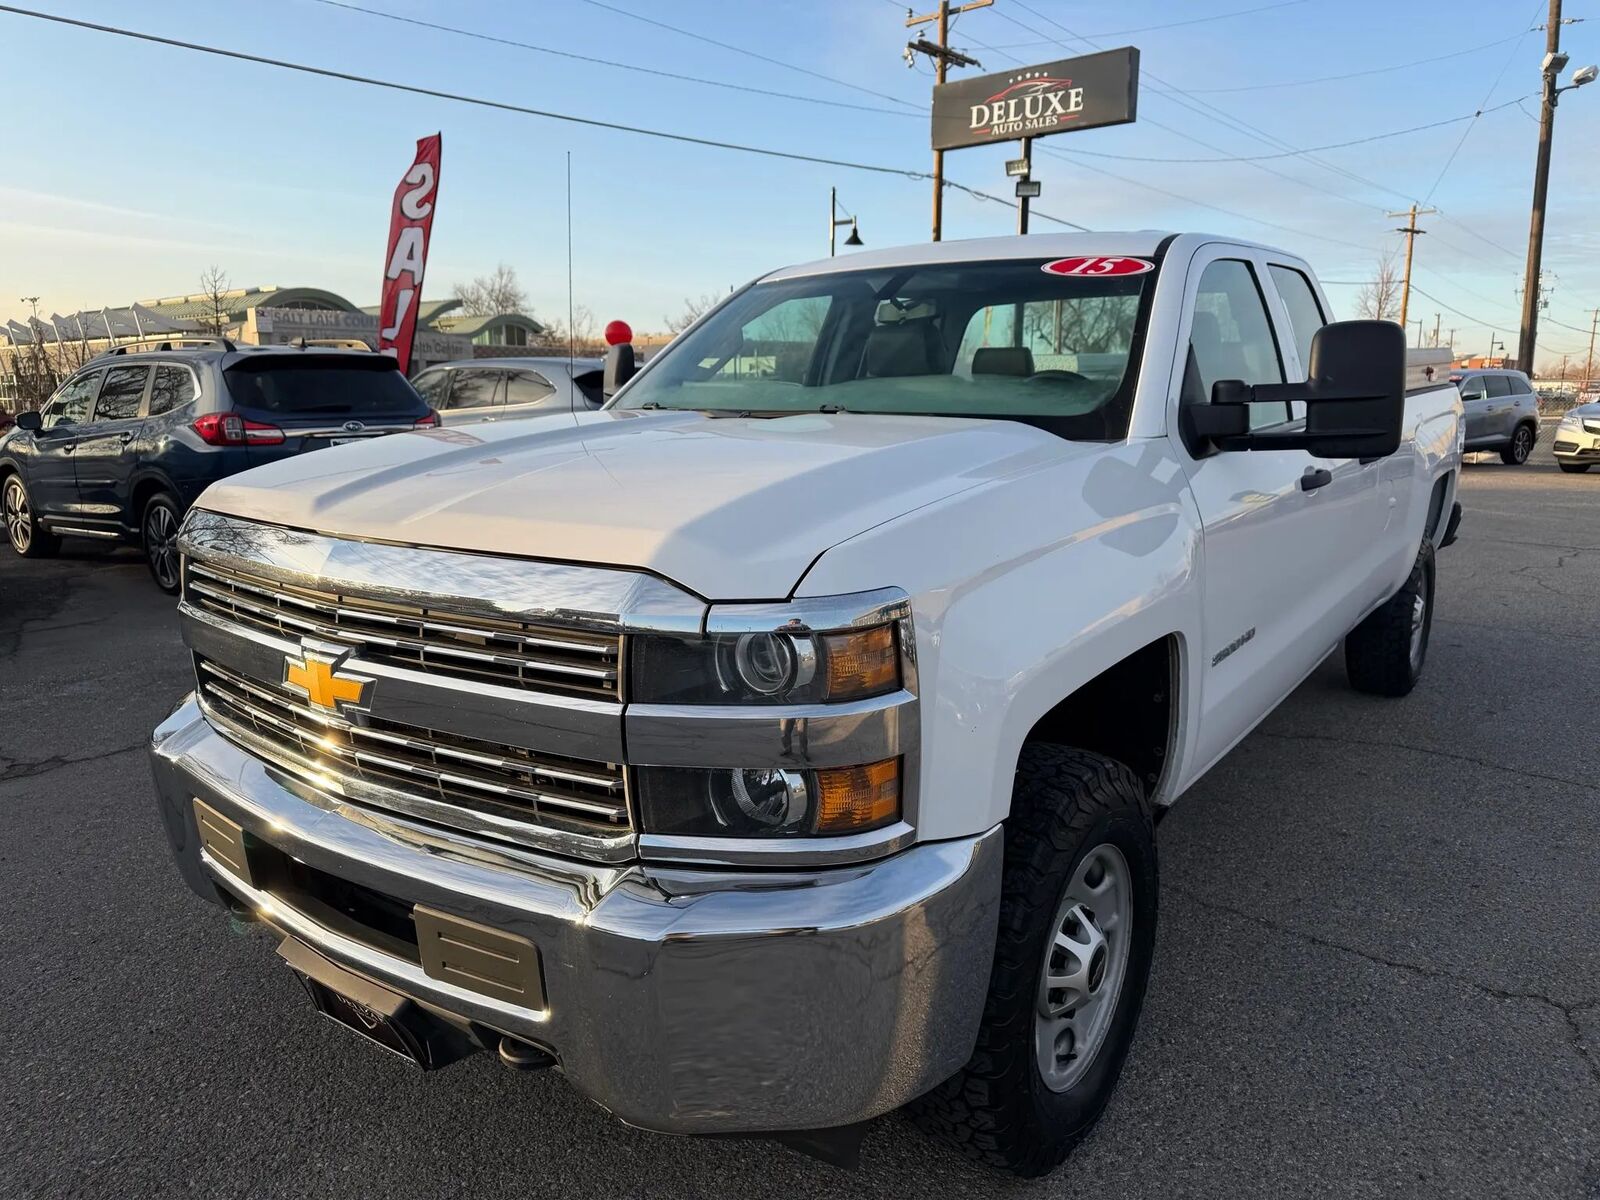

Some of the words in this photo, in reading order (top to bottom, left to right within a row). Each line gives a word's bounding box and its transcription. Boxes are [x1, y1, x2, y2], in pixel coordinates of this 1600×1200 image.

[969, 87, 1084, 129] DELUXE
[991, 121, 1022, 136] AUTO
[1025, 115, 1058, 130] SALES
[1064, 258, 1125, 274] 15
[273, 311, 305, 323] SALT
